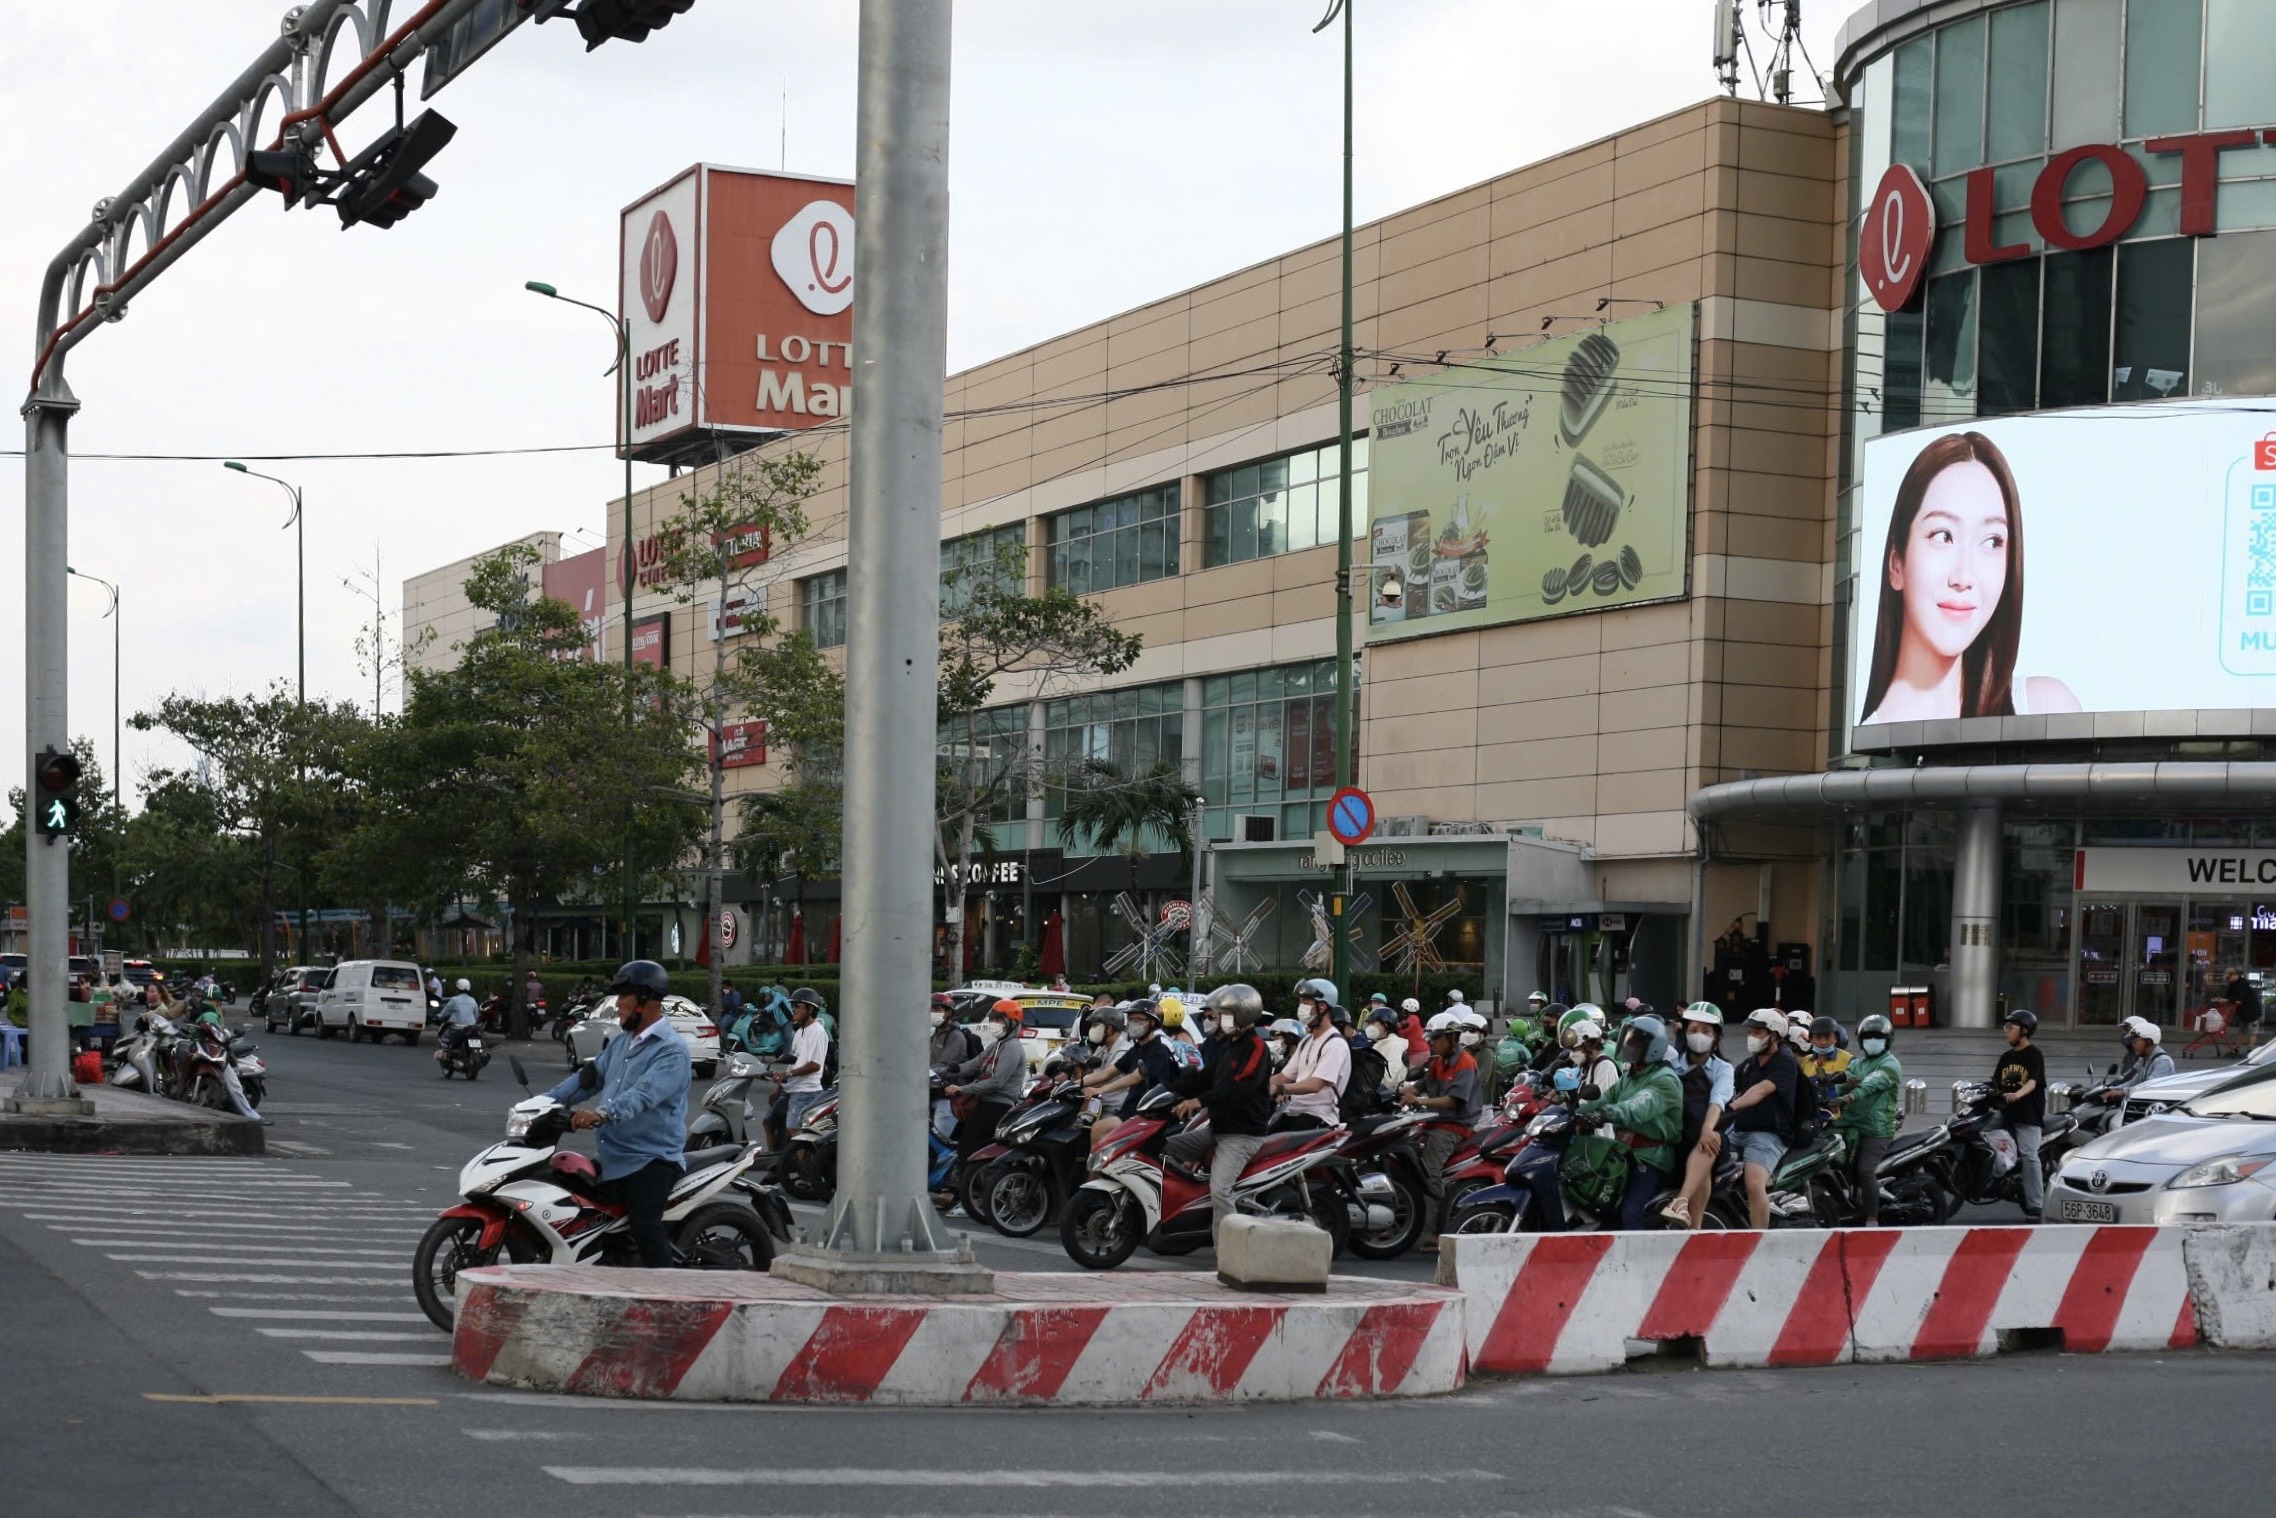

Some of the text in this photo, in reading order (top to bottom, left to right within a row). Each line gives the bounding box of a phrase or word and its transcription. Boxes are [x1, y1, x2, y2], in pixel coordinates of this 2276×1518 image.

[1964, 129, 2276, 264] LOT
[635, 337, 680, 381] LOTTE
[634, 373, 678, 430] Mart
[1373, 396, 1433, 425] CHOCOLAT
[1453, 407, 1493, 455] Yêu
[1455, 456, 1483, 482] Ngon
[1507, 431, 1520, 457] Vị
[2187, 858, 2276, 883] WELC
[2065, 1203, 2111, 1221] 56P-3648
